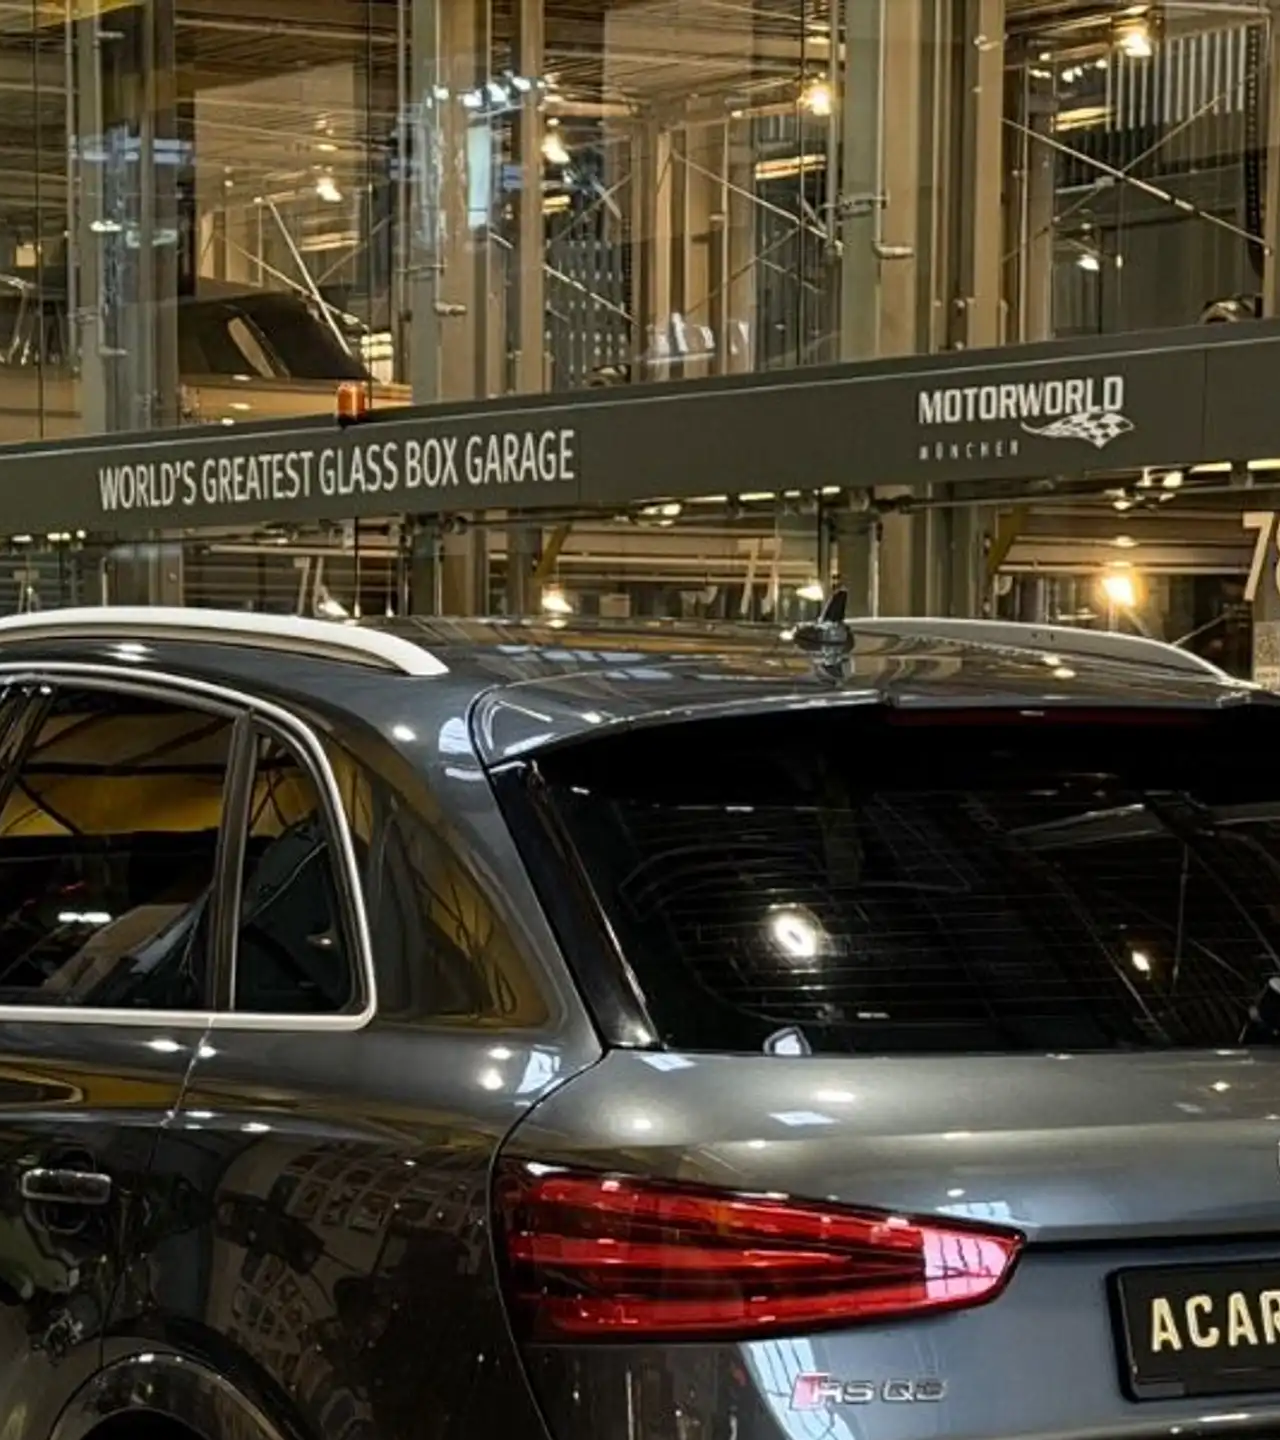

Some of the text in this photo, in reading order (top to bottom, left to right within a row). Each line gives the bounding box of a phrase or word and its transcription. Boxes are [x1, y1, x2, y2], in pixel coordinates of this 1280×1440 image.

[919, 375, 1124, 424] MOTORWORLD
[99, 428, 575, 511] WORLD'S GREATEST GLASS BOX GARAGE
